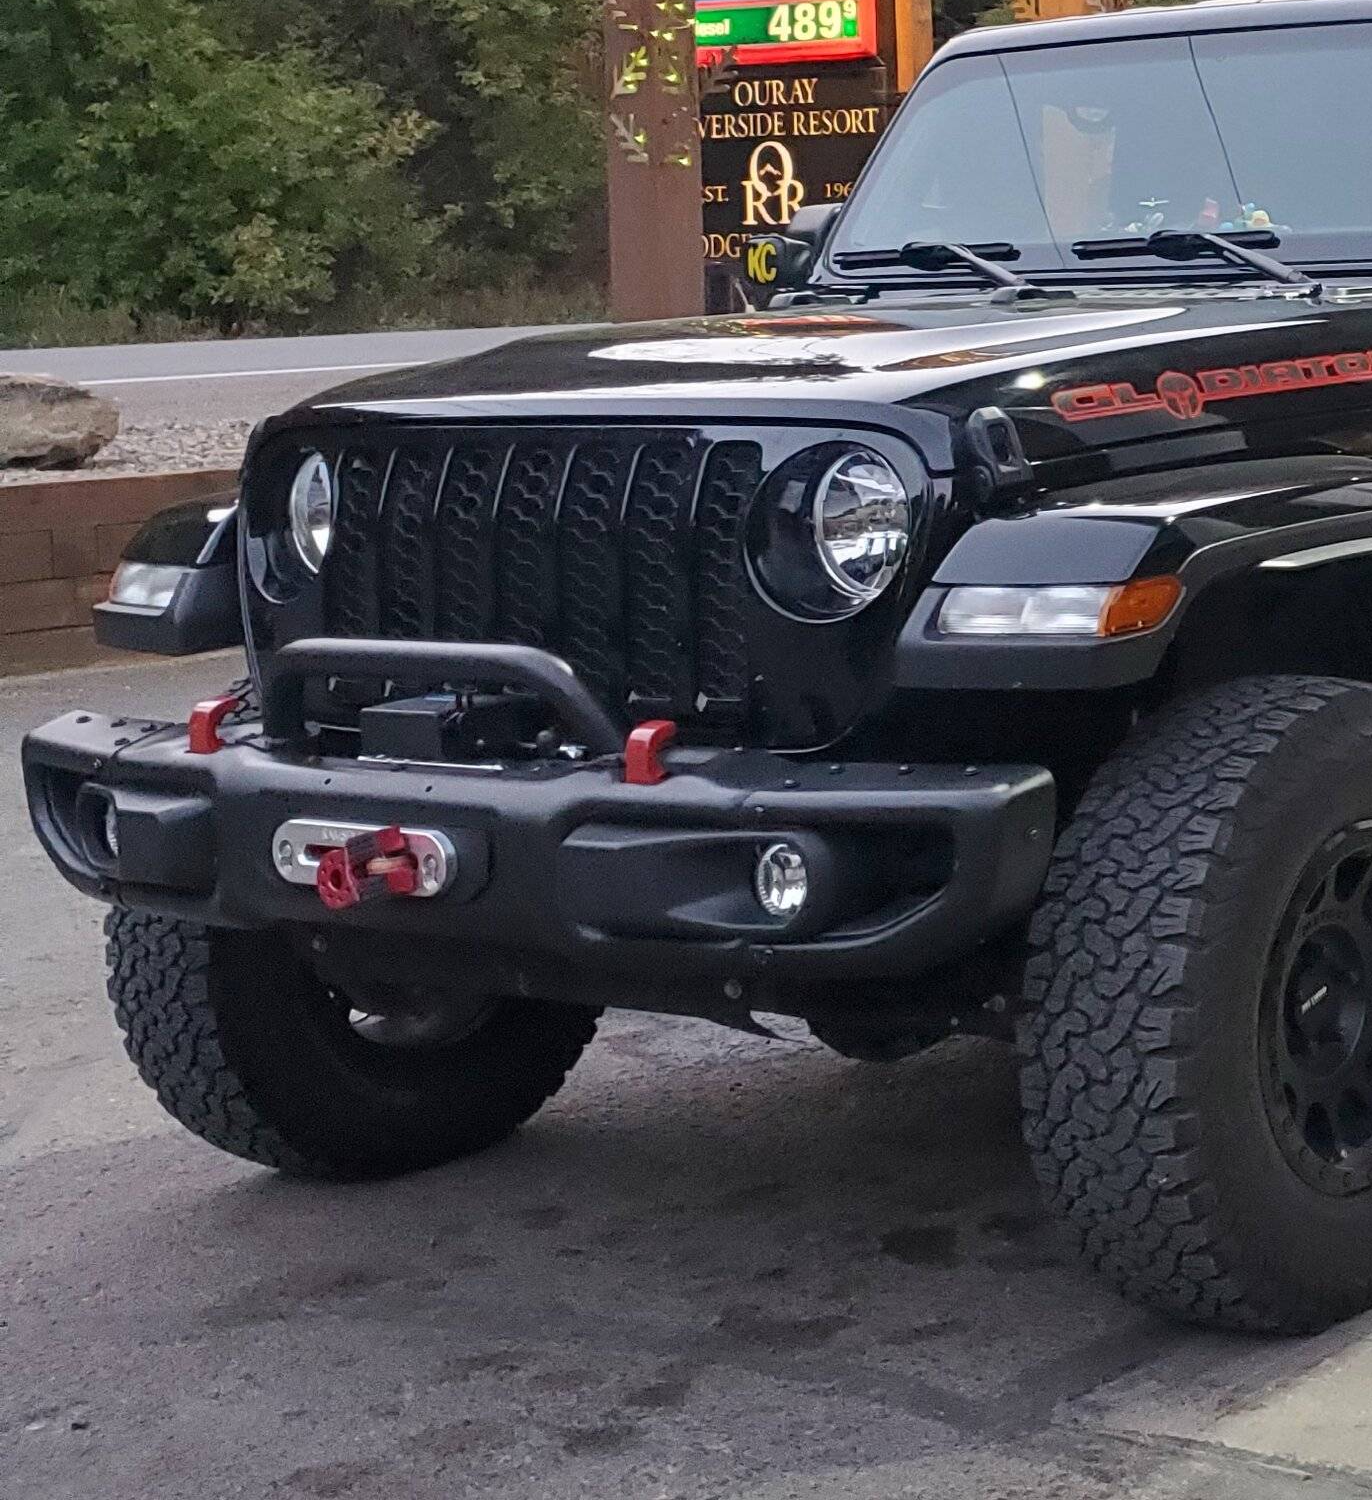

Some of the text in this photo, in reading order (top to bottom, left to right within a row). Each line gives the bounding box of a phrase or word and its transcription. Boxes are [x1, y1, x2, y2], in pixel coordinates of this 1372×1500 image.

[734, 78, 818, 107] OURAY
[793, 108, 879, 136] RESORT
[748, 242, 777, 284] KC
